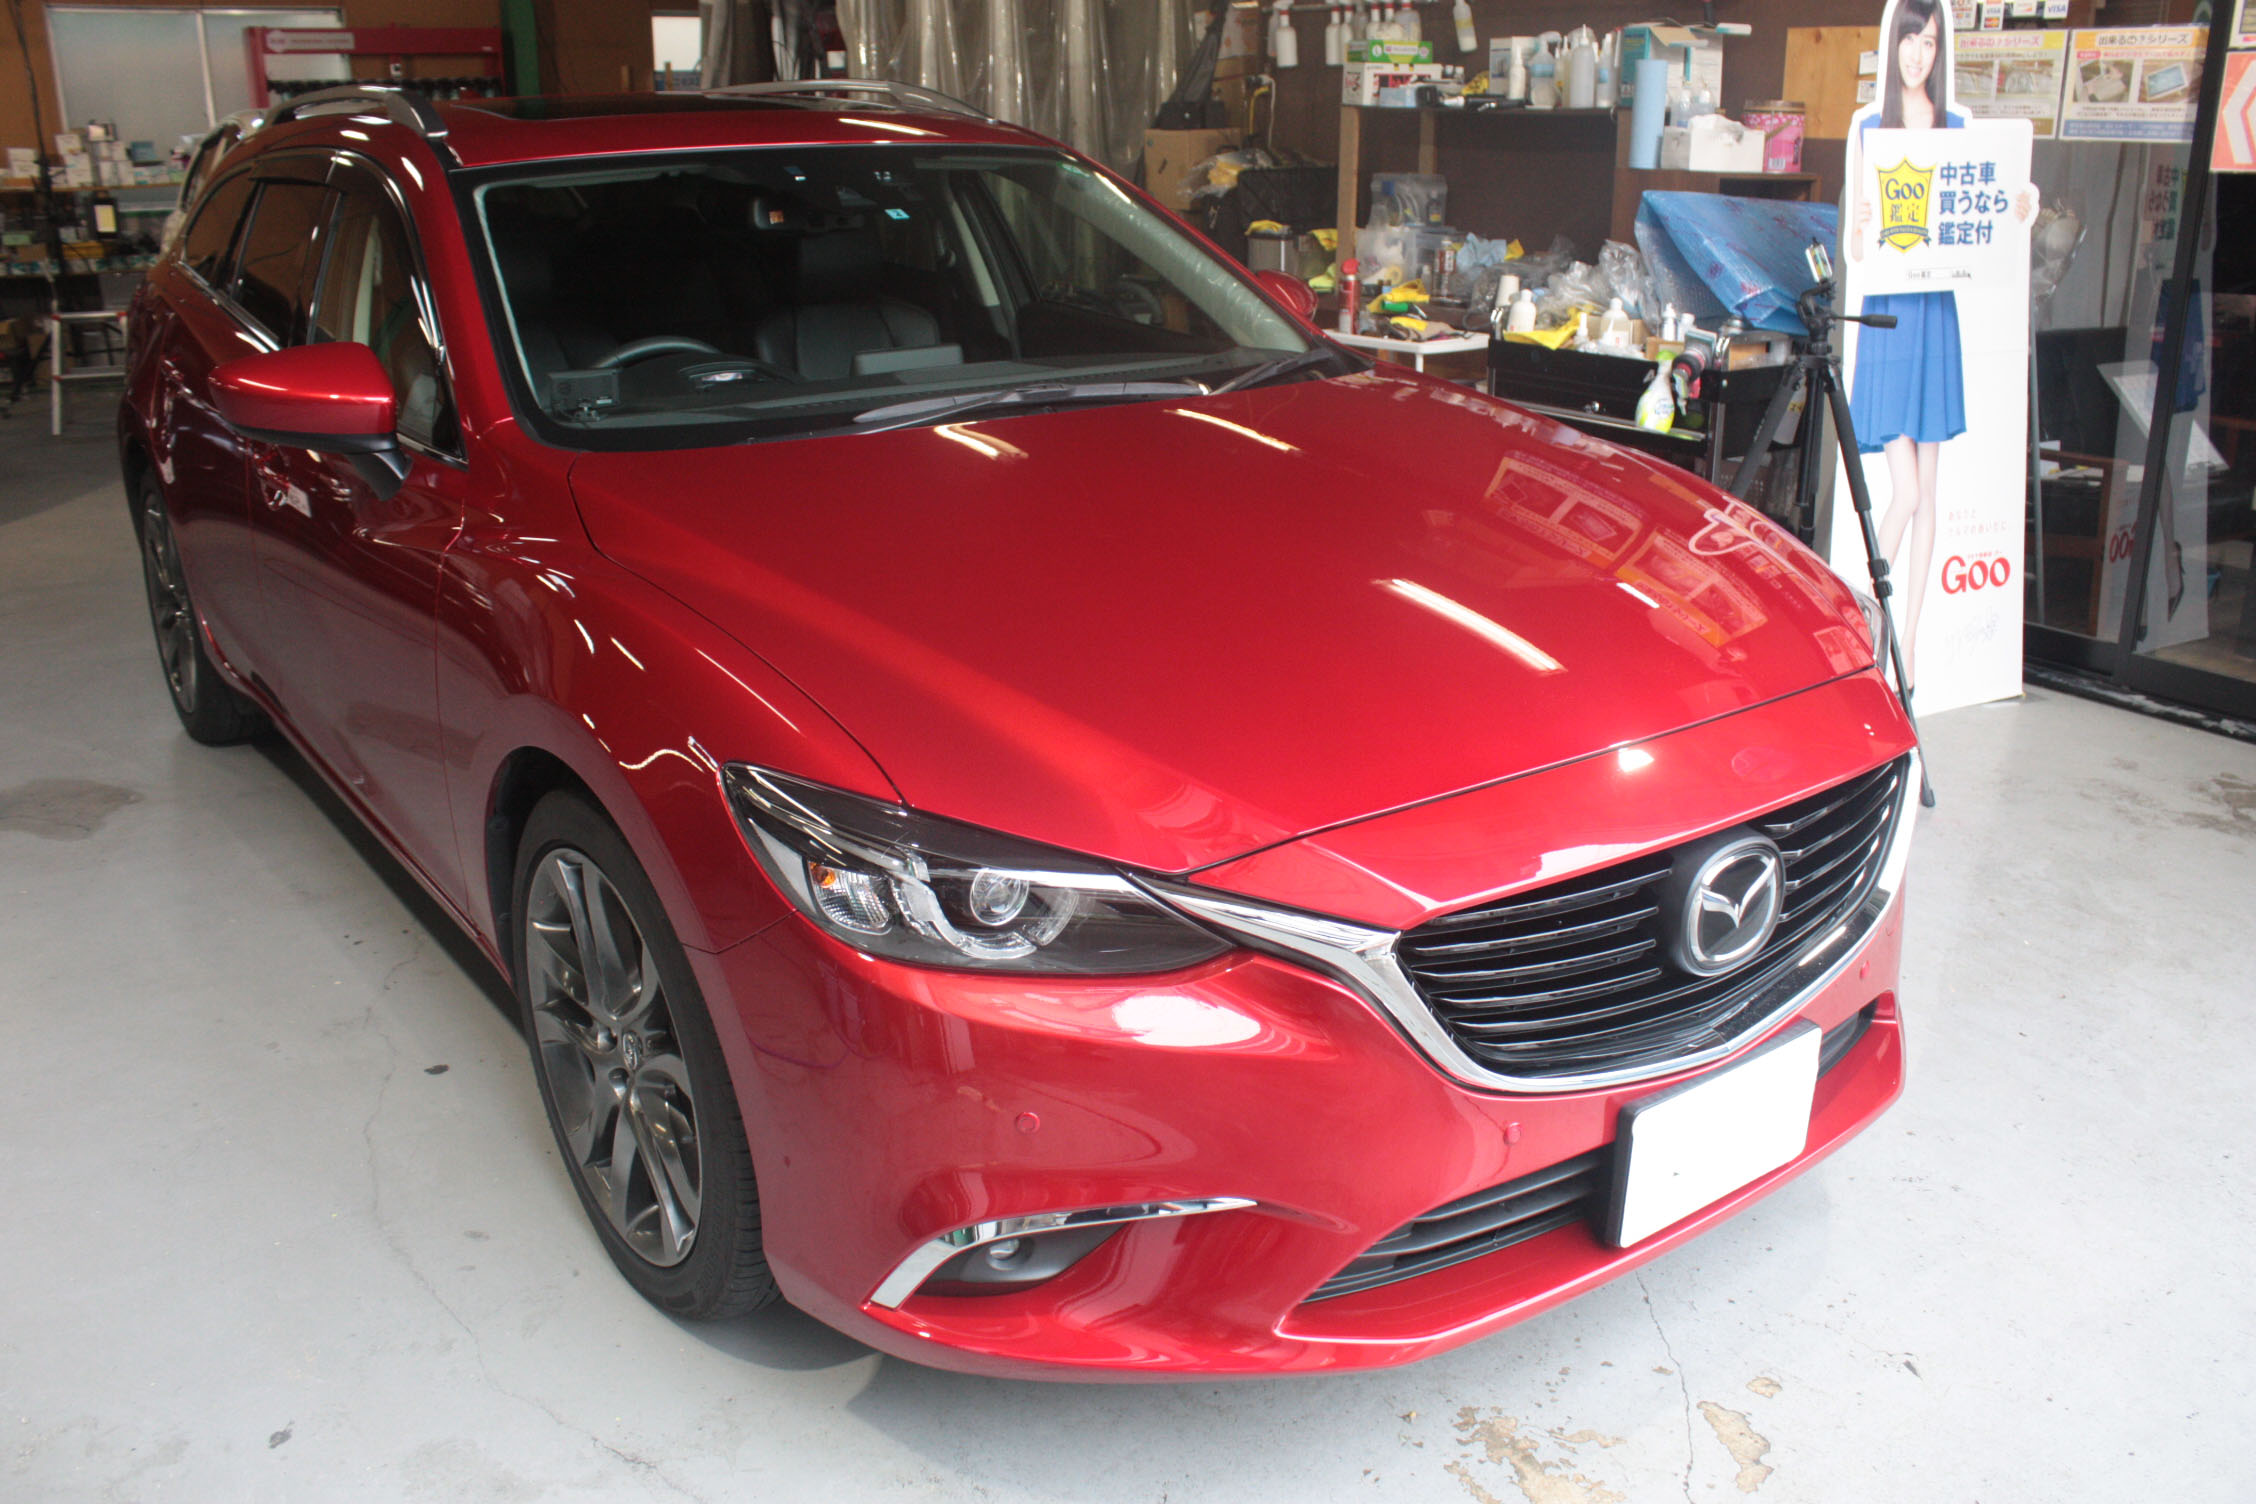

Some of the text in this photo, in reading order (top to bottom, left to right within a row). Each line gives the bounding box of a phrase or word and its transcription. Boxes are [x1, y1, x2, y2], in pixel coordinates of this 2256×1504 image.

[2048, 5, 2066, 13] VISA
[1940, 161, 1996, 186] 中古車
[1885, 178, 1925, 200] Goo
[1939, 189, 2009, 215] 買うなら
[1938, 219, 1993, 246] 鑑定付
[1941, 555, 2011, 594] Goo
